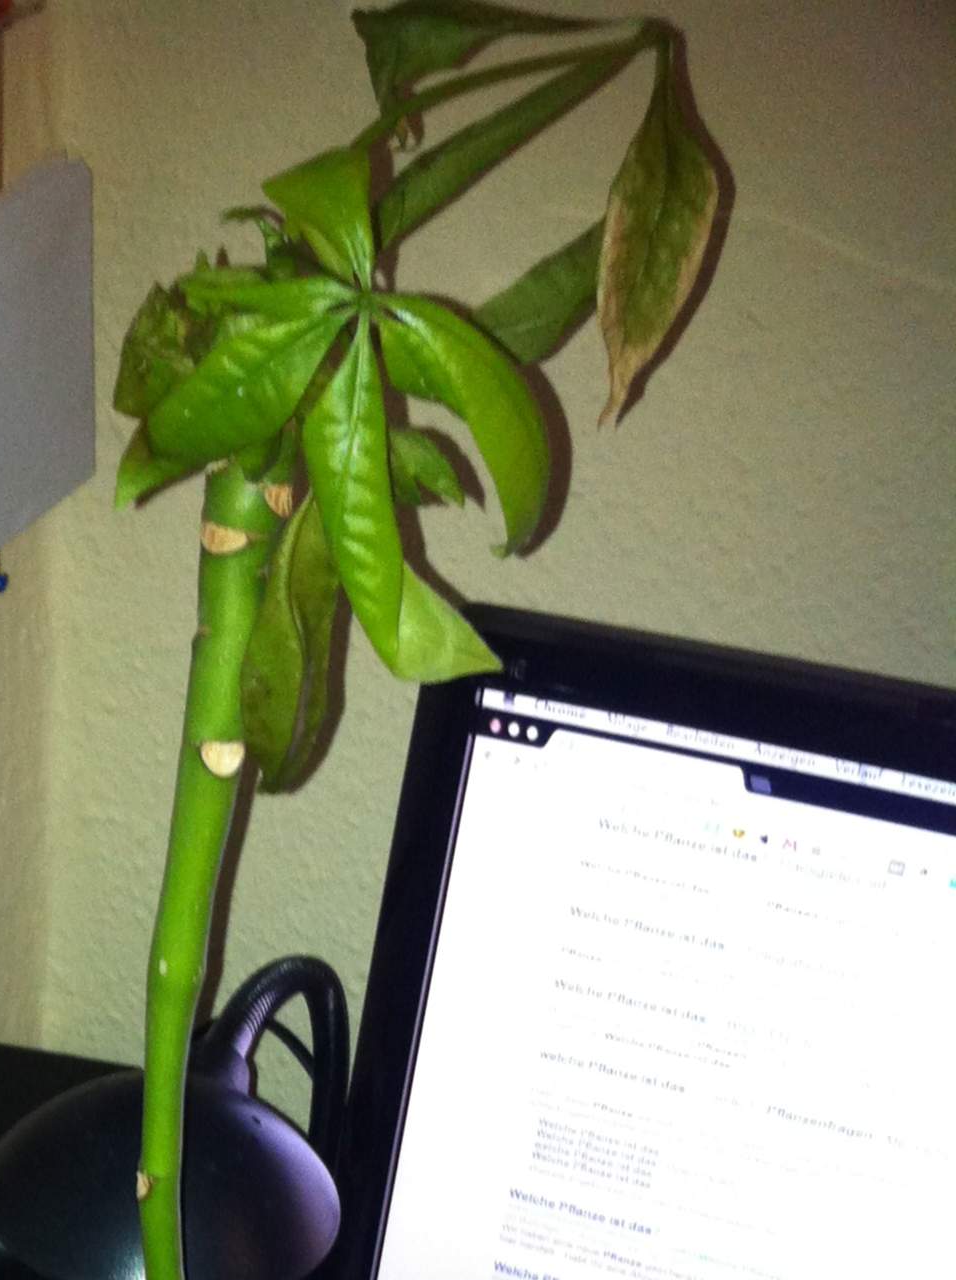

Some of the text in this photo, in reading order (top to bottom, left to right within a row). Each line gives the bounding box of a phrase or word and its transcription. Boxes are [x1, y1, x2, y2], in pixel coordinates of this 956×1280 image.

[598, 816, 649, 839] Welche
[654, 827, 706, 851] Pflanze
[569, 904, 620, 927] Welche
[623, 916, 675, 939] Pflanze
[554, 976, 602, 998] Welche
[606, 989, 657, 1012] Pflanze
[508, 1186, 556, 1210] Welche
[558, 1199, 606, 1224] Pflanze
